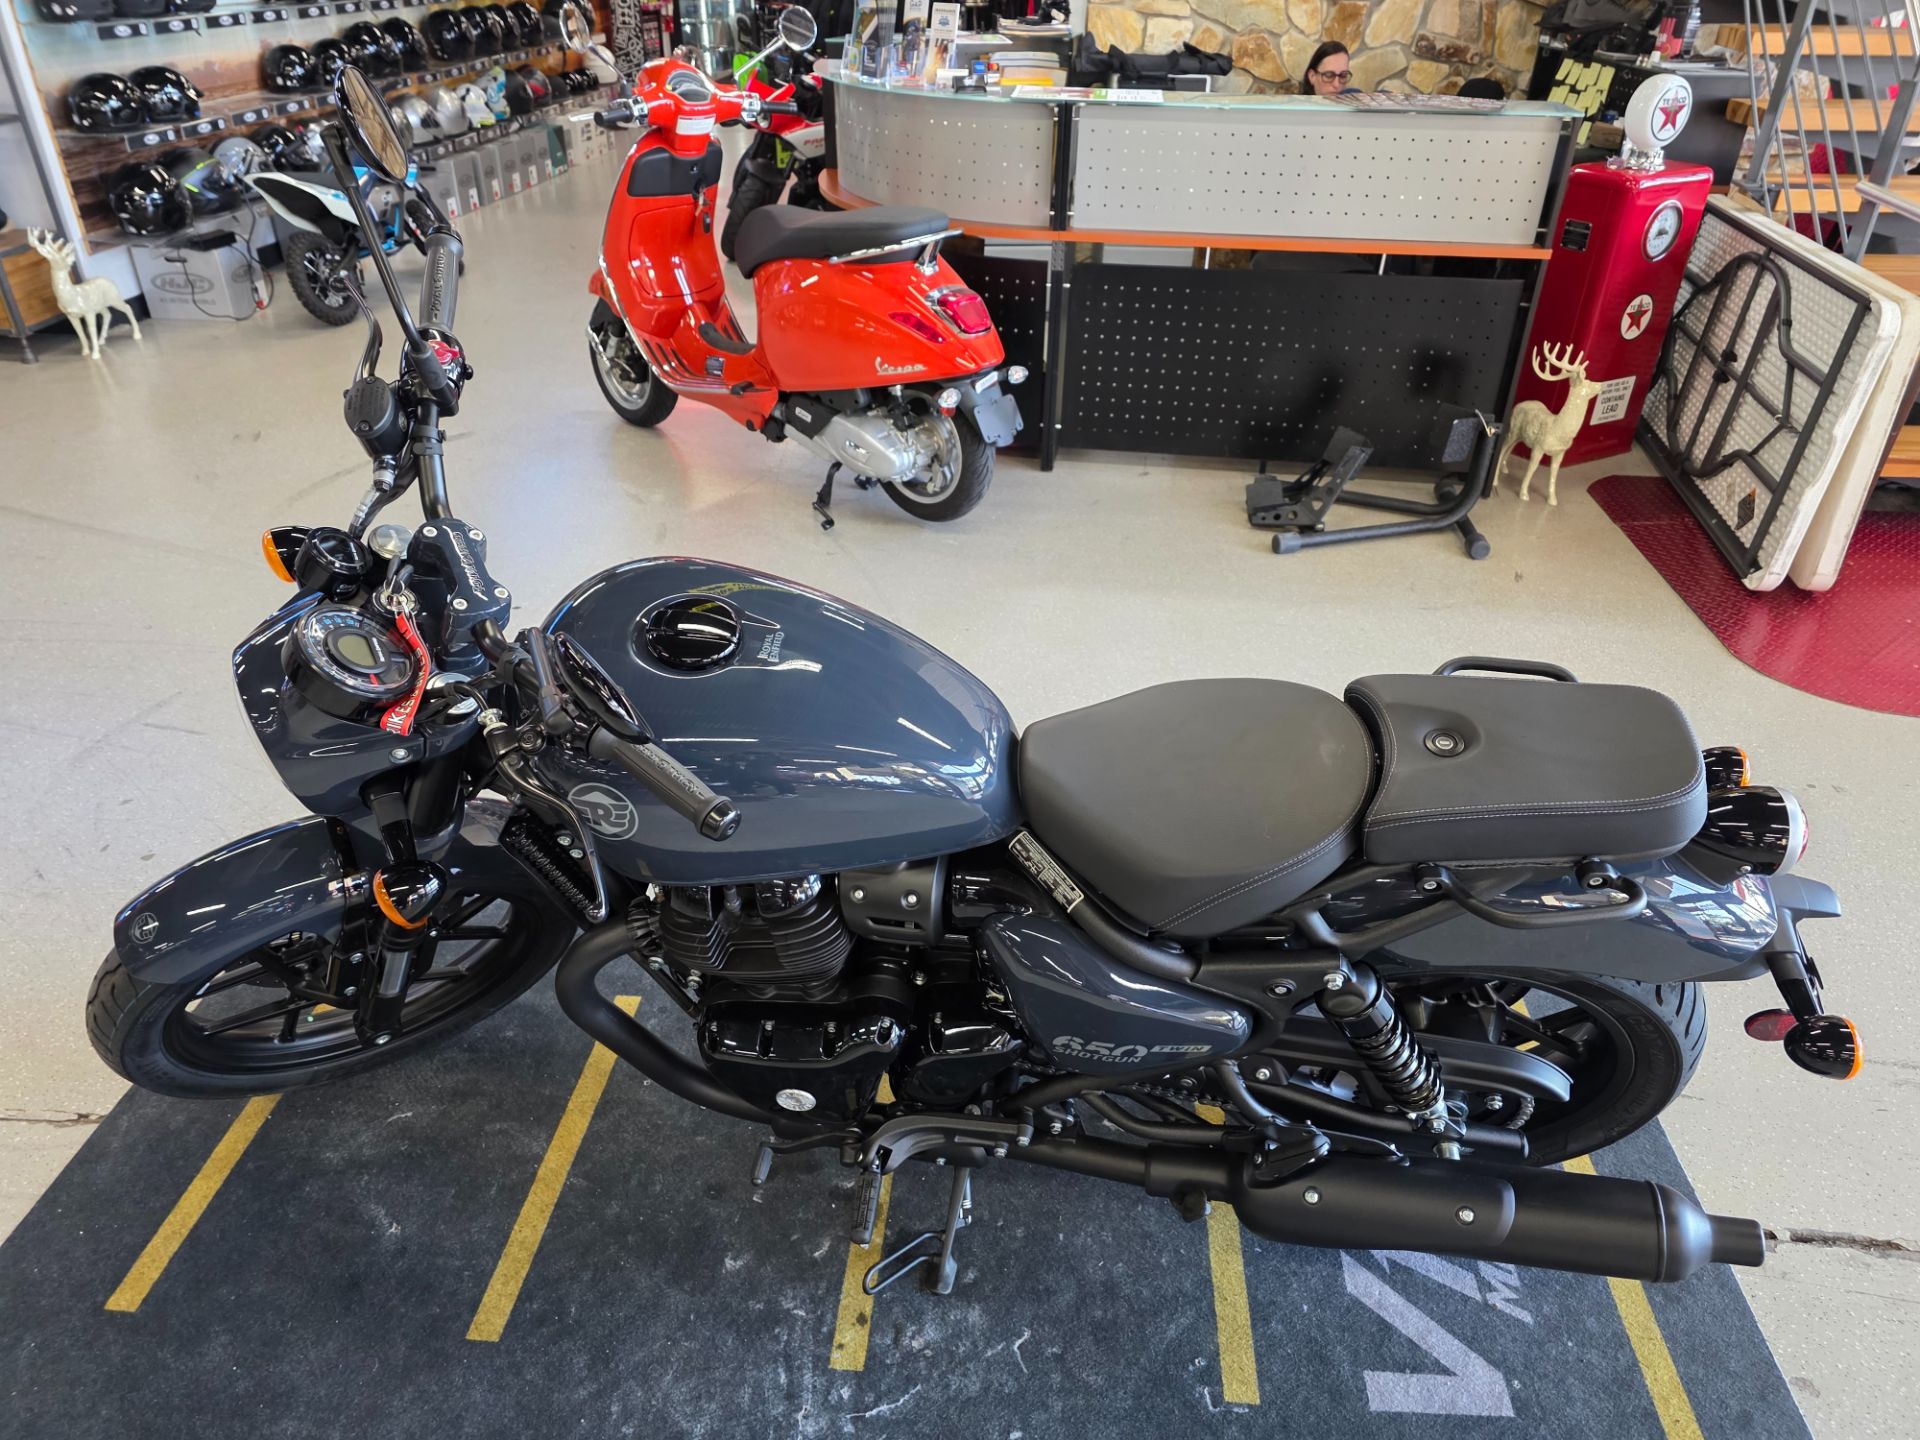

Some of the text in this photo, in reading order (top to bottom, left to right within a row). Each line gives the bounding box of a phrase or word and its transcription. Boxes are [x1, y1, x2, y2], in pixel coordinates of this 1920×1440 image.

[1602, 403, 1618, 415] LEAD
[757, 633, 774, 659] ROYAL
[767, 631, 785, 662] ENFIELD
[1052, 1035, 1149, 1058] 650
[1053, 1045, 1142, 1063] SHOTGUN
